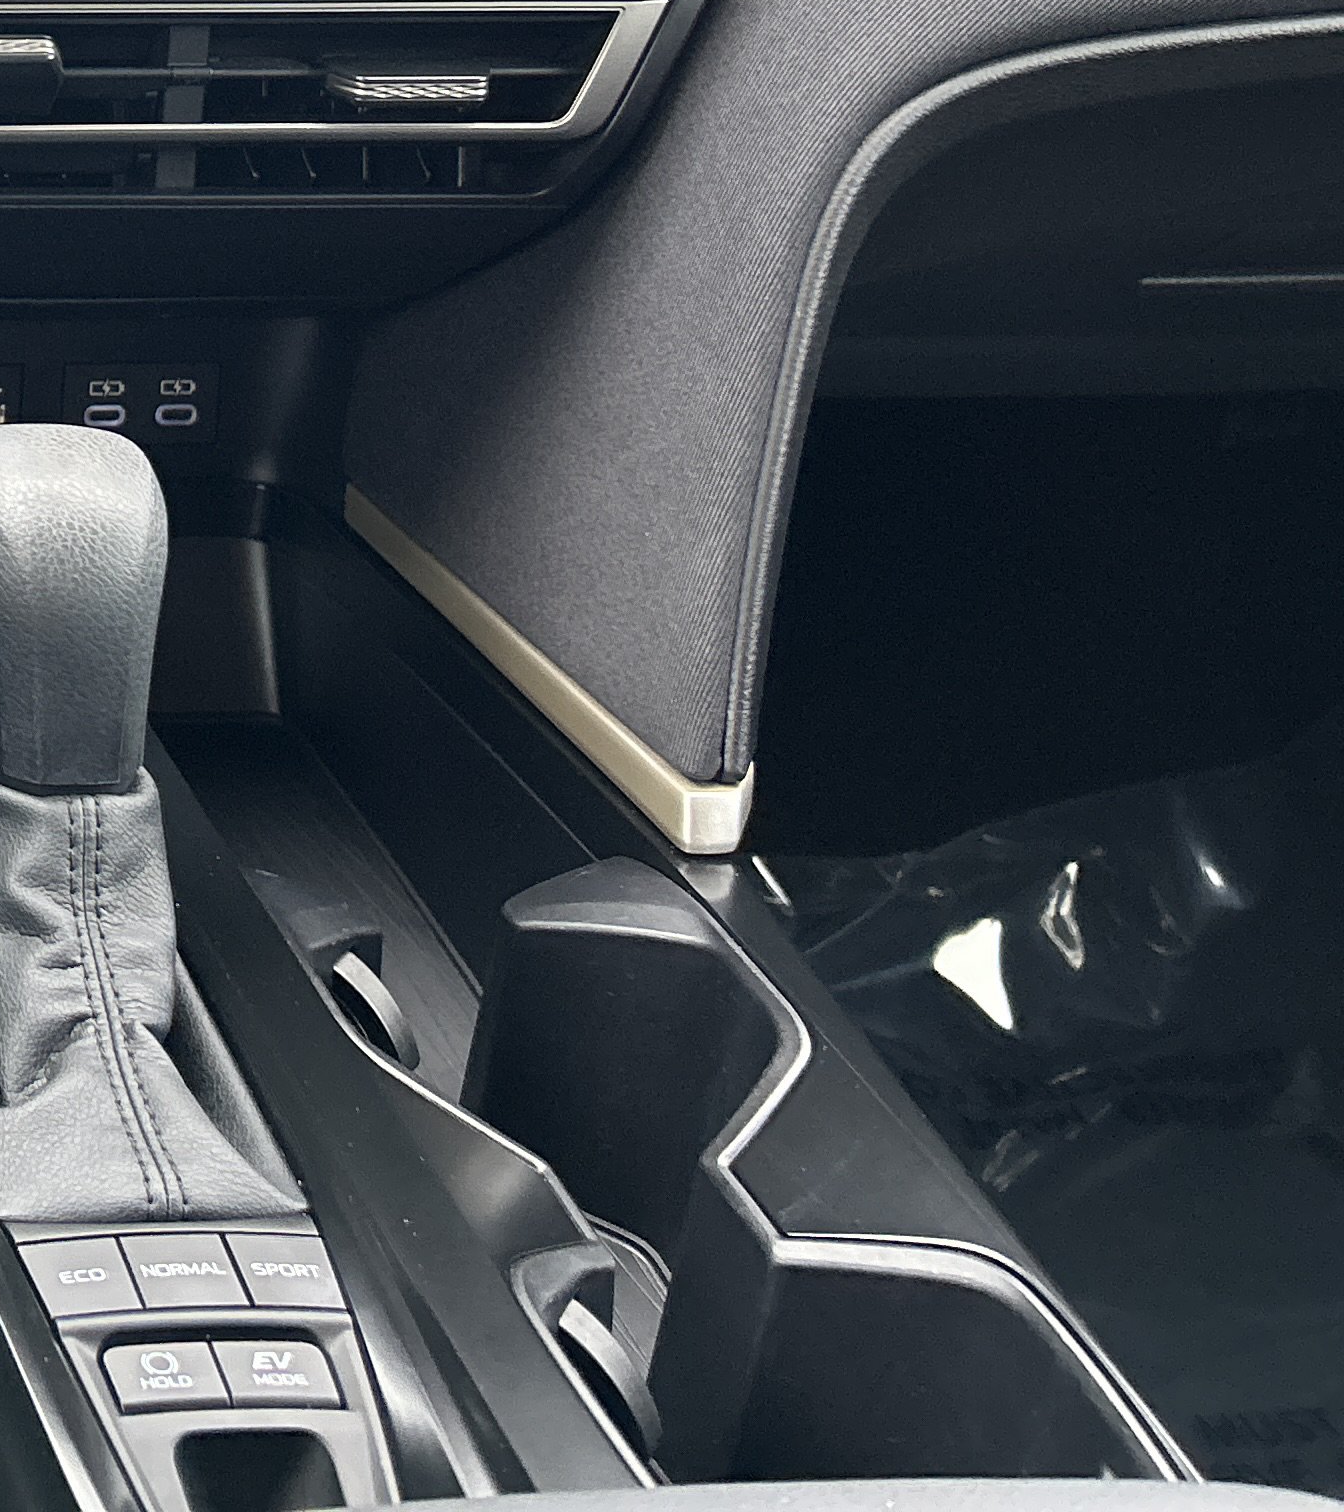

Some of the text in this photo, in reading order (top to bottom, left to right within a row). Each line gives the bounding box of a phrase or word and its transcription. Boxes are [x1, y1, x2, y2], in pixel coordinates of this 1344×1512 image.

[58, 1267, 107, 1284] ECO
[140, 1261, 227, 1278] NORMAL
[250, 1262, 320, 1279] SPORT
[251, 1351, 293, 1369] EV
[140, 1374, 193, 1389] HOLD
[252, 1373, 309, 1387] MODE
